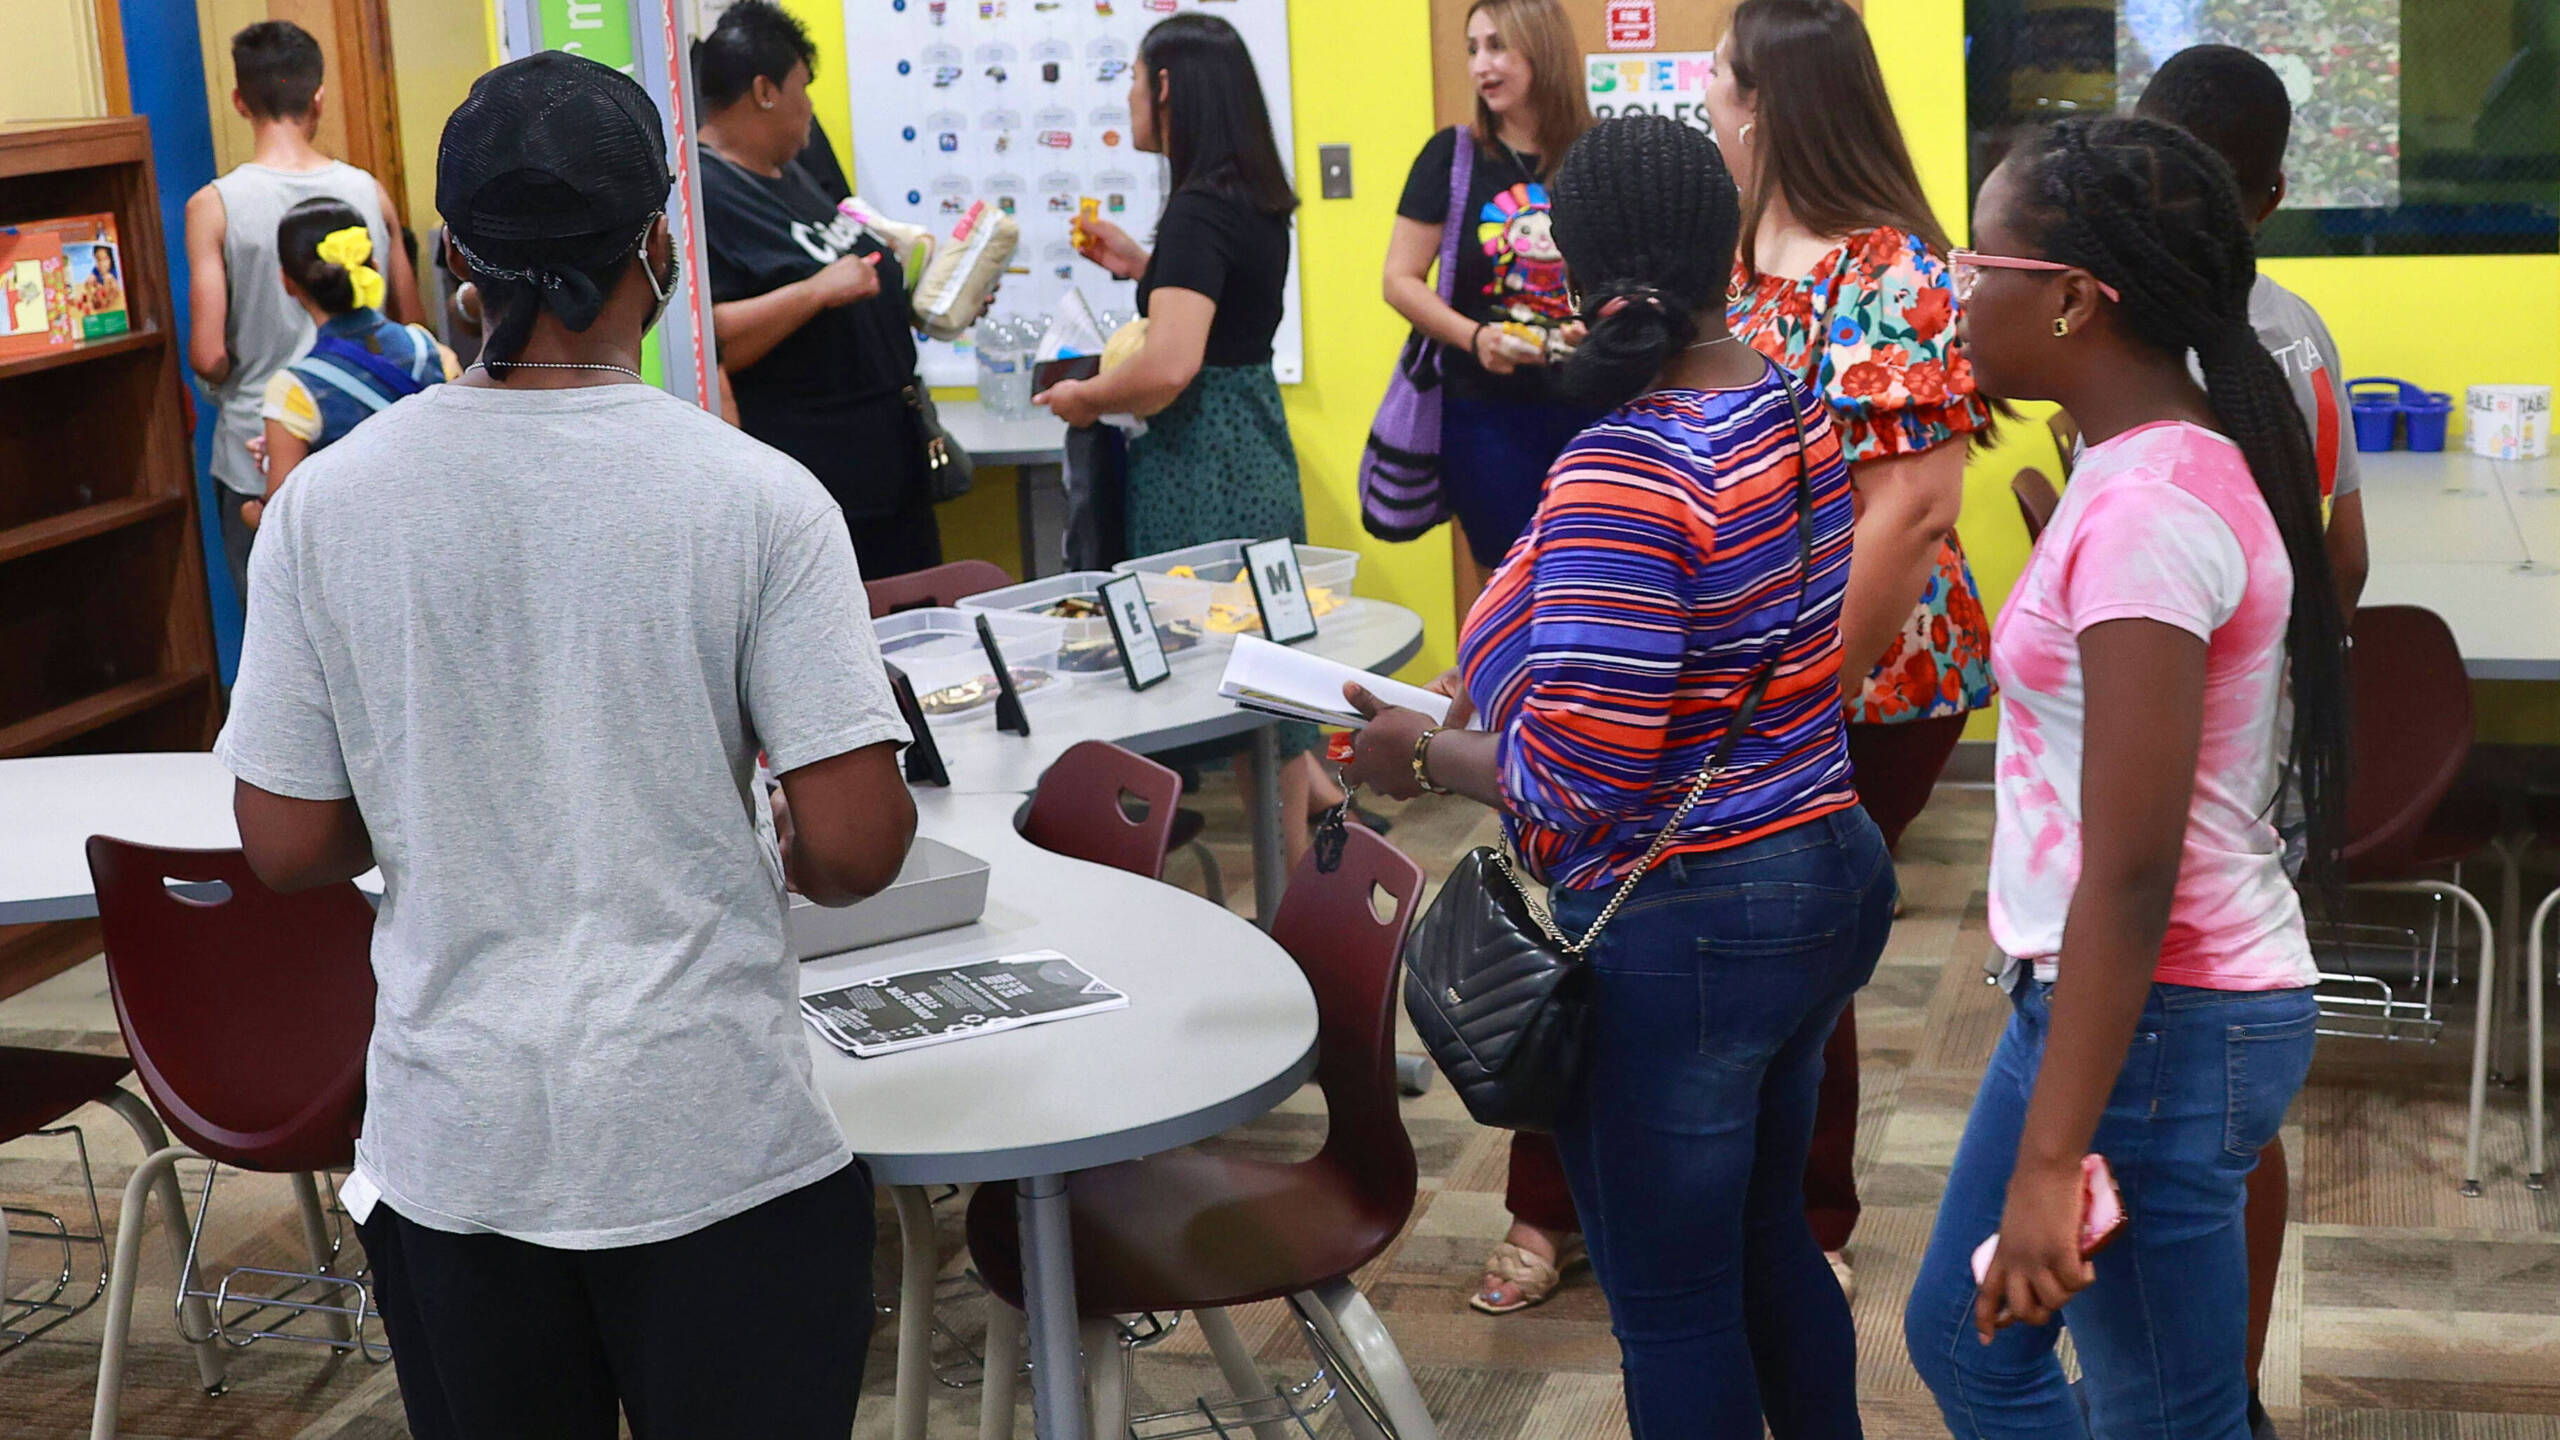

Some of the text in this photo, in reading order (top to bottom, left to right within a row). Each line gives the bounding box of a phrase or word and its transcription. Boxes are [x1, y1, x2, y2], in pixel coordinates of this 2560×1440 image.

[1591, 60, 1710, 93] STEM
[1265, 560, 1291, 595] M
[1124, 602, 1143, 635] E
